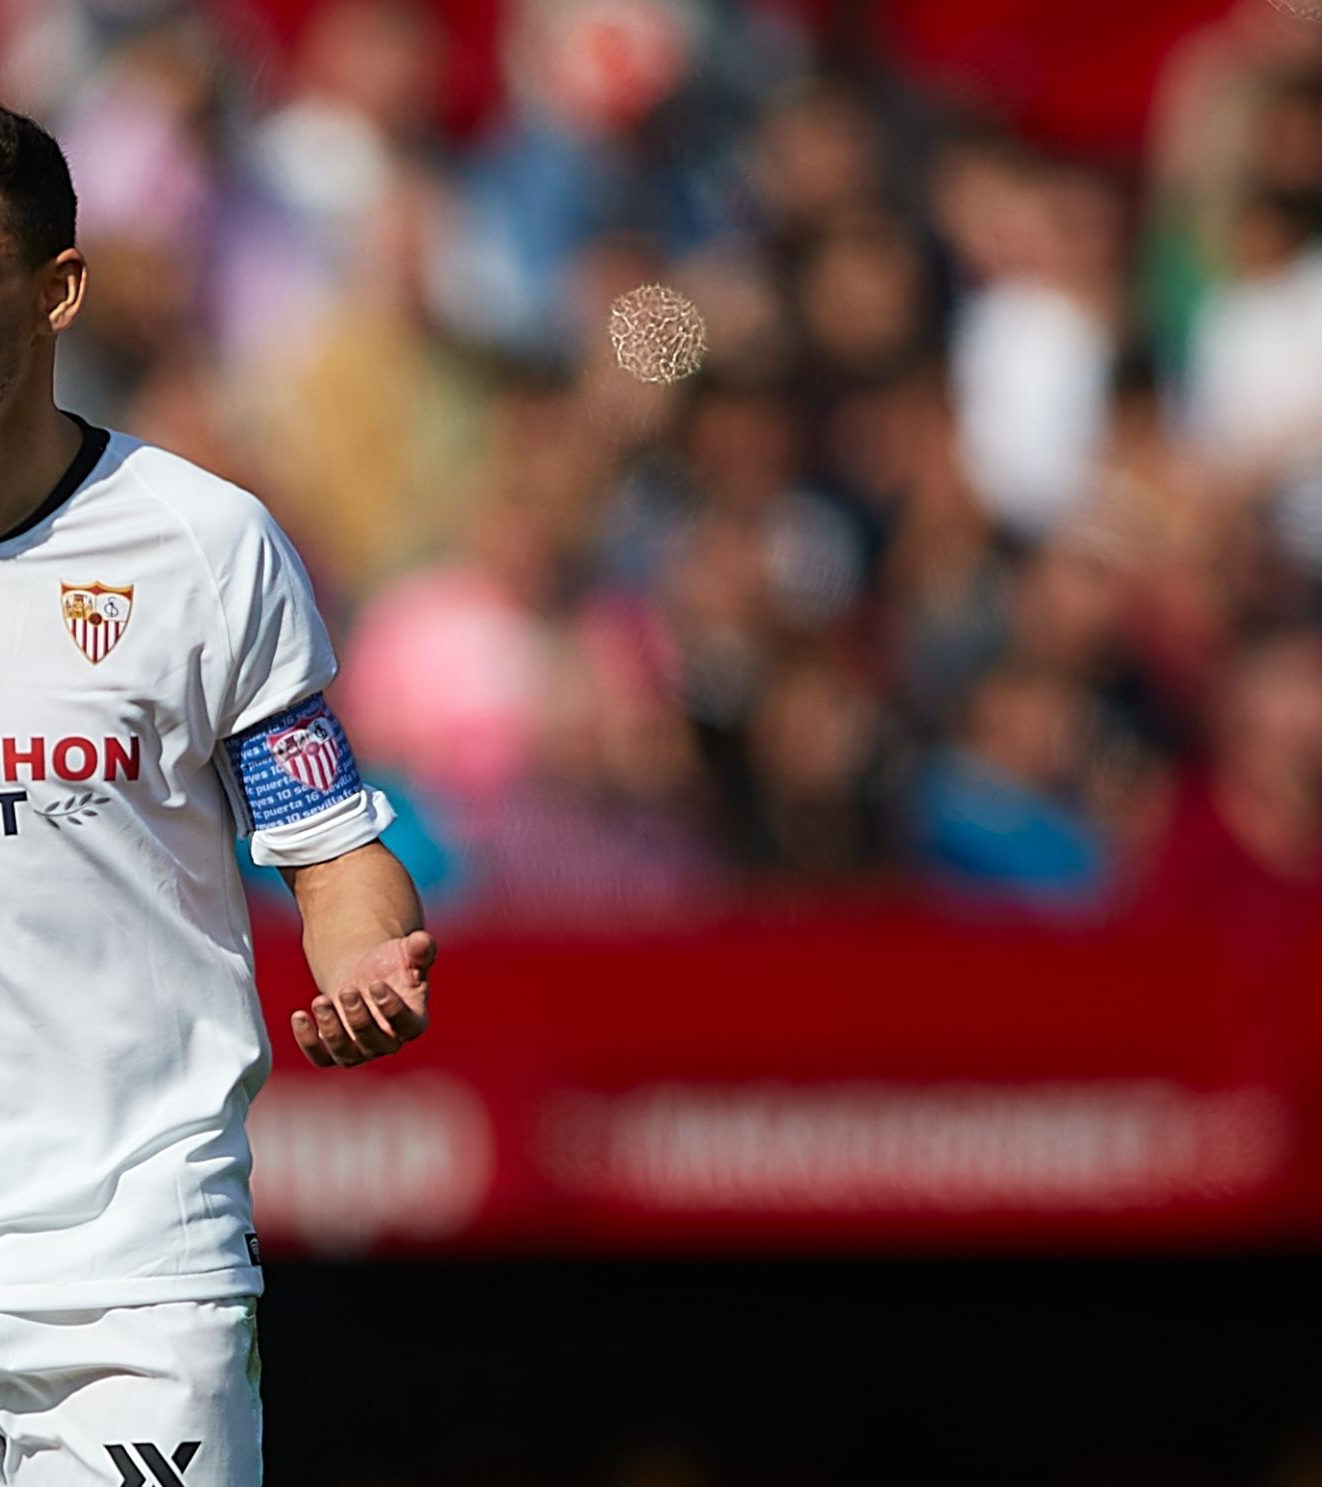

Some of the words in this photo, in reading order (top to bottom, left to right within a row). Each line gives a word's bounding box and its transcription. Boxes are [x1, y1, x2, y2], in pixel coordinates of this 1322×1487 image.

[276, 788, 292, 801] 10
[263, 799, 303, 820] puerta
[305, 789, 320, 804] 16
[286, 812, 301, 825] 10
